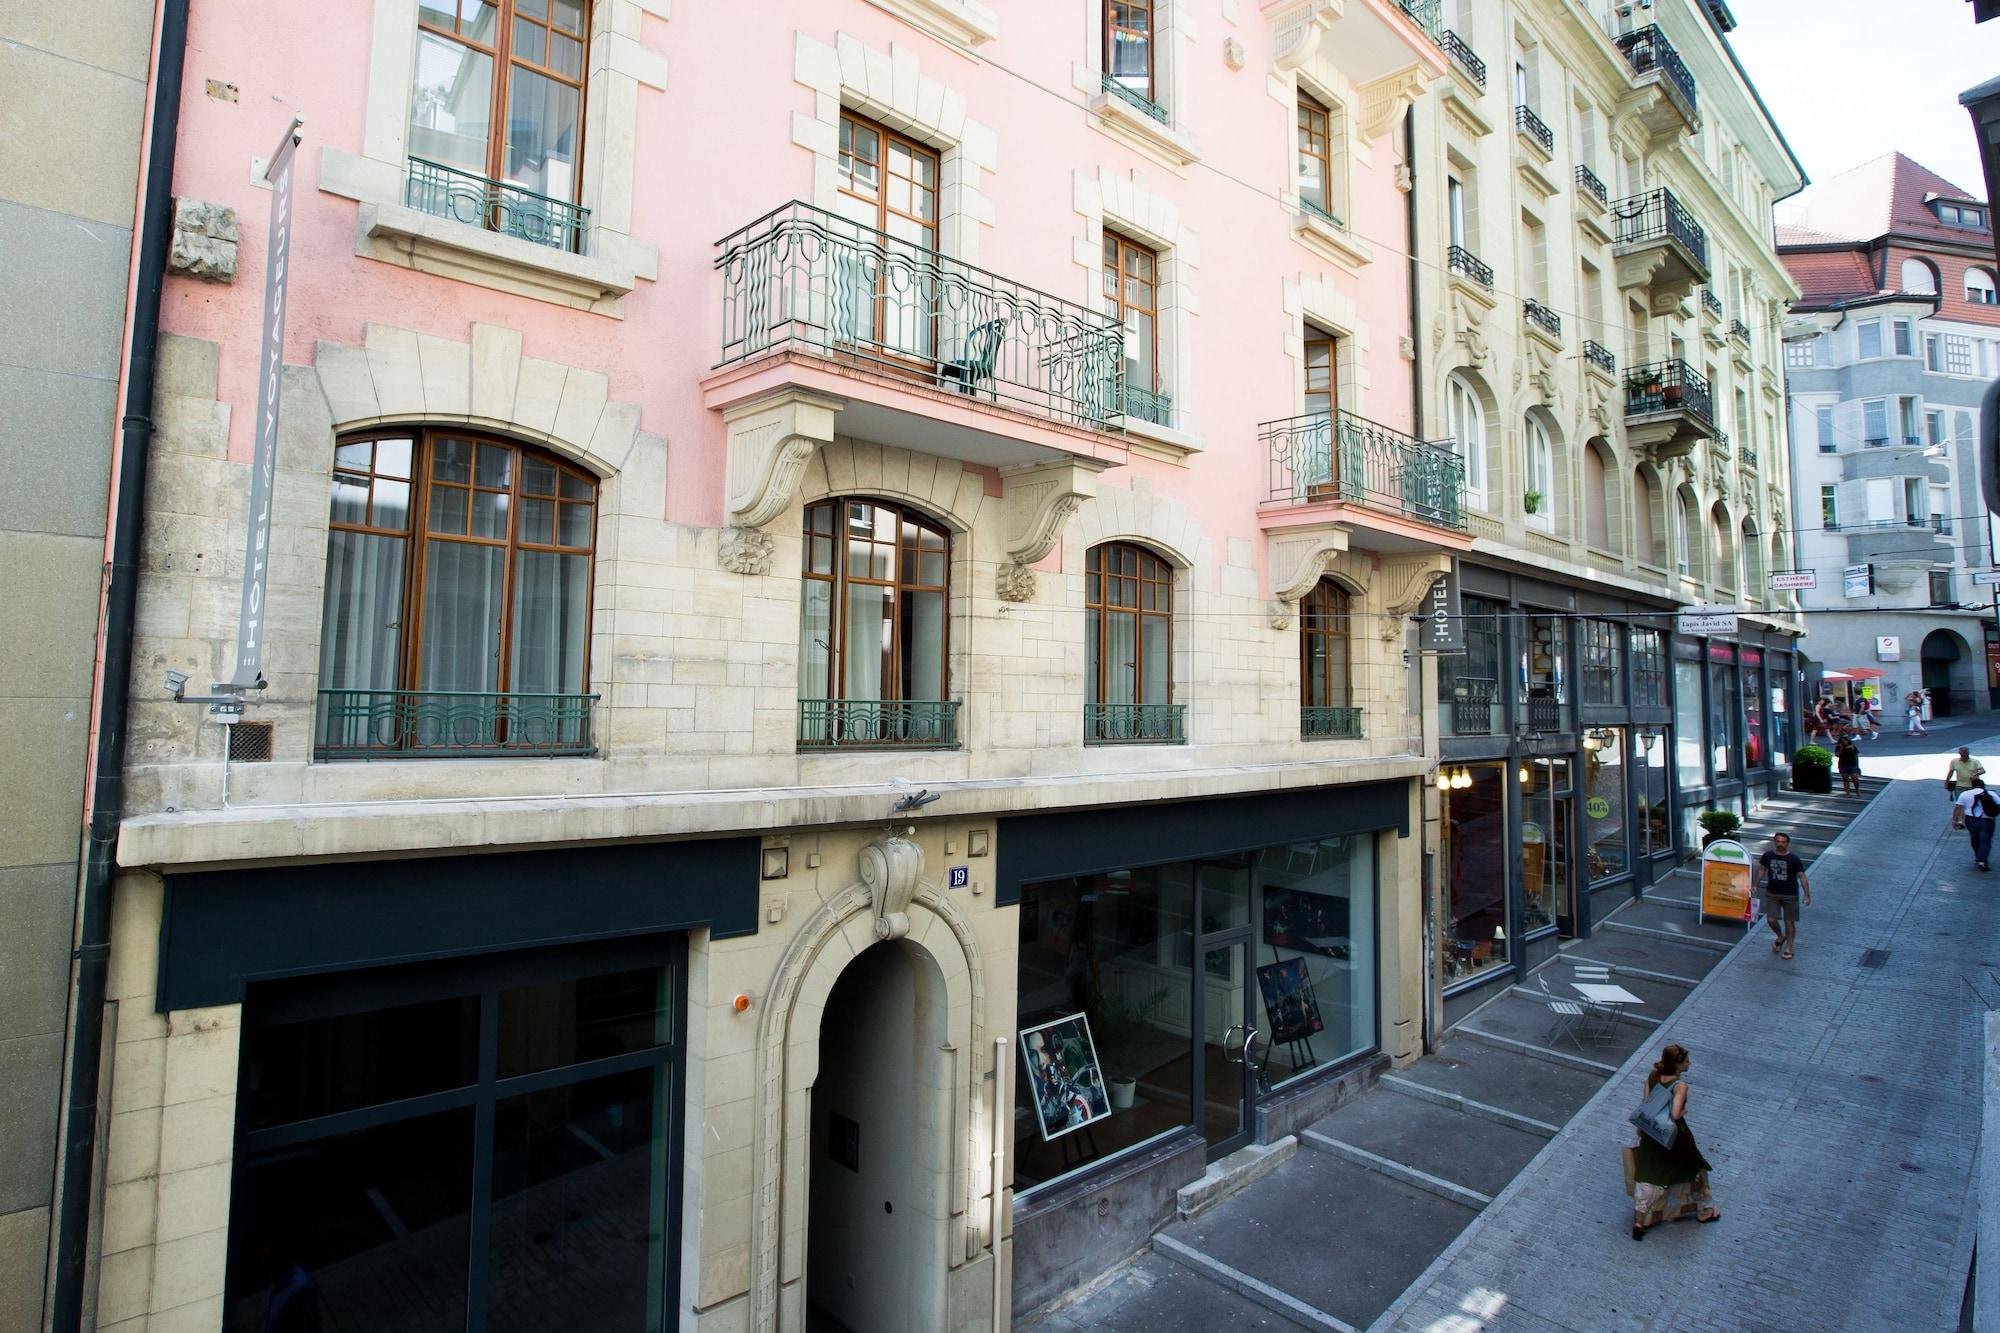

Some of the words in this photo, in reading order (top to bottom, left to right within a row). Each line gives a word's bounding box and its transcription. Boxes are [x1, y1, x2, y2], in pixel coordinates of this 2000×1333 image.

[265, 167, 289, 438] VOYAGEURS
[1586, 801, 1608, 813] 40%
[953, 869, 965, 886] 19
